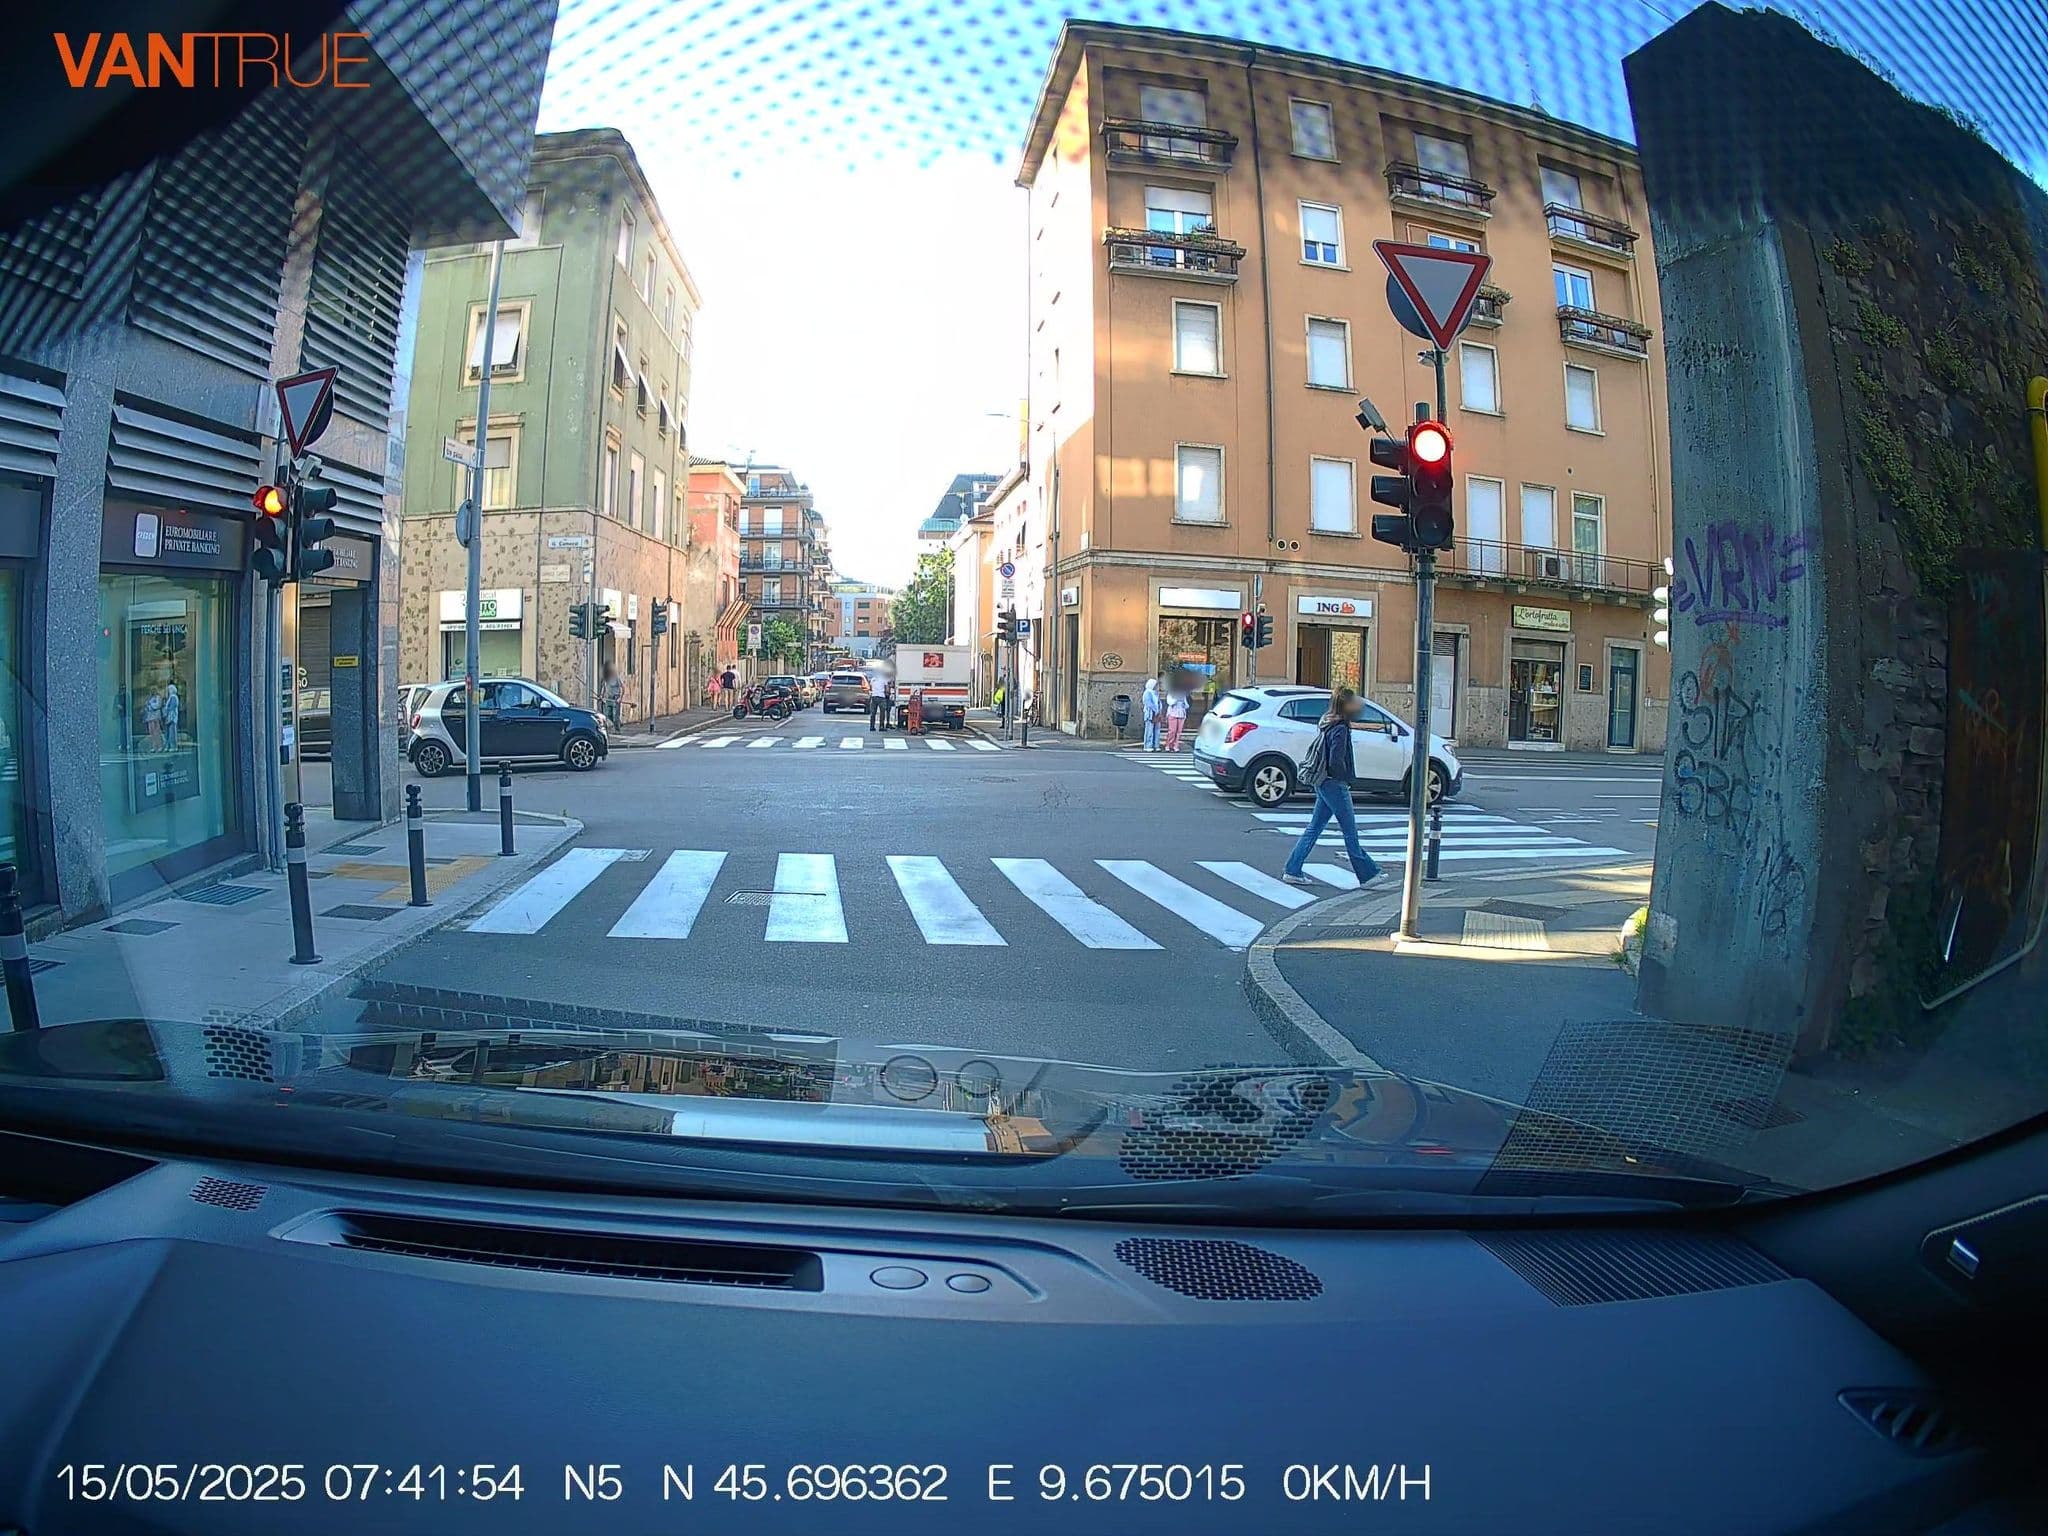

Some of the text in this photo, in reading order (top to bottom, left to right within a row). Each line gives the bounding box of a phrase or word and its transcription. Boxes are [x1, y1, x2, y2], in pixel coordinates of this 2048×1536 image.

[165, 526, 217, 542] EUROMOBILIARE
[164, 539, 220, 555] PRIVATE BANKING
[1317, 602, 1339, 613] ING
